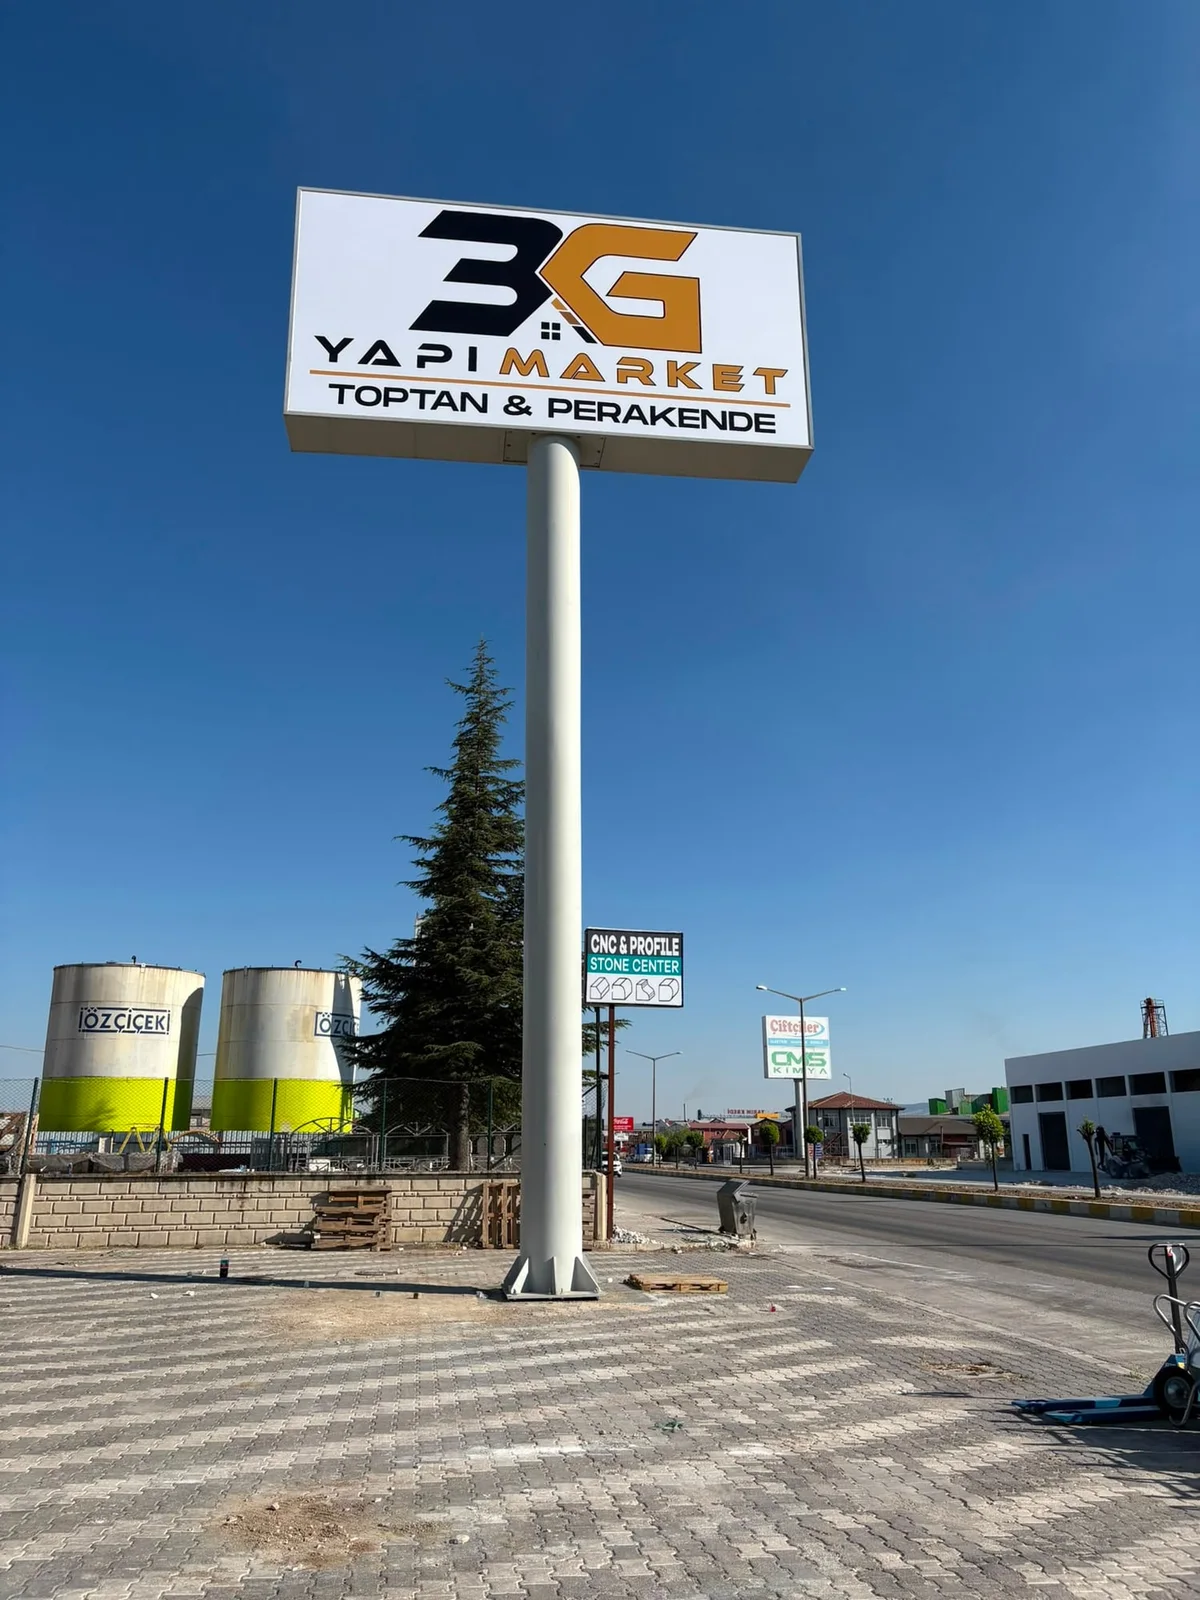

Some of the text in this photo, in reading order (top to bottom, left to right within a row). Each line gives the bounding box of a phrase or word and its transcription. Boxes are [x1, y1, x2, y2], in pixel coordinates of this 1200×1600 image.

[409, 209, 703, 354] 3G
[314, 335, 788, 395] YAPI MARKET
[328, 383, 776, 434] TOPTAN & PERAKENDE
[591, 934, 679, 956] CNC & PROFILE
[590, 957, 679, 973] STONE CENTER
[84, 1007, 165, 1033] ÖZÇİÇEK
